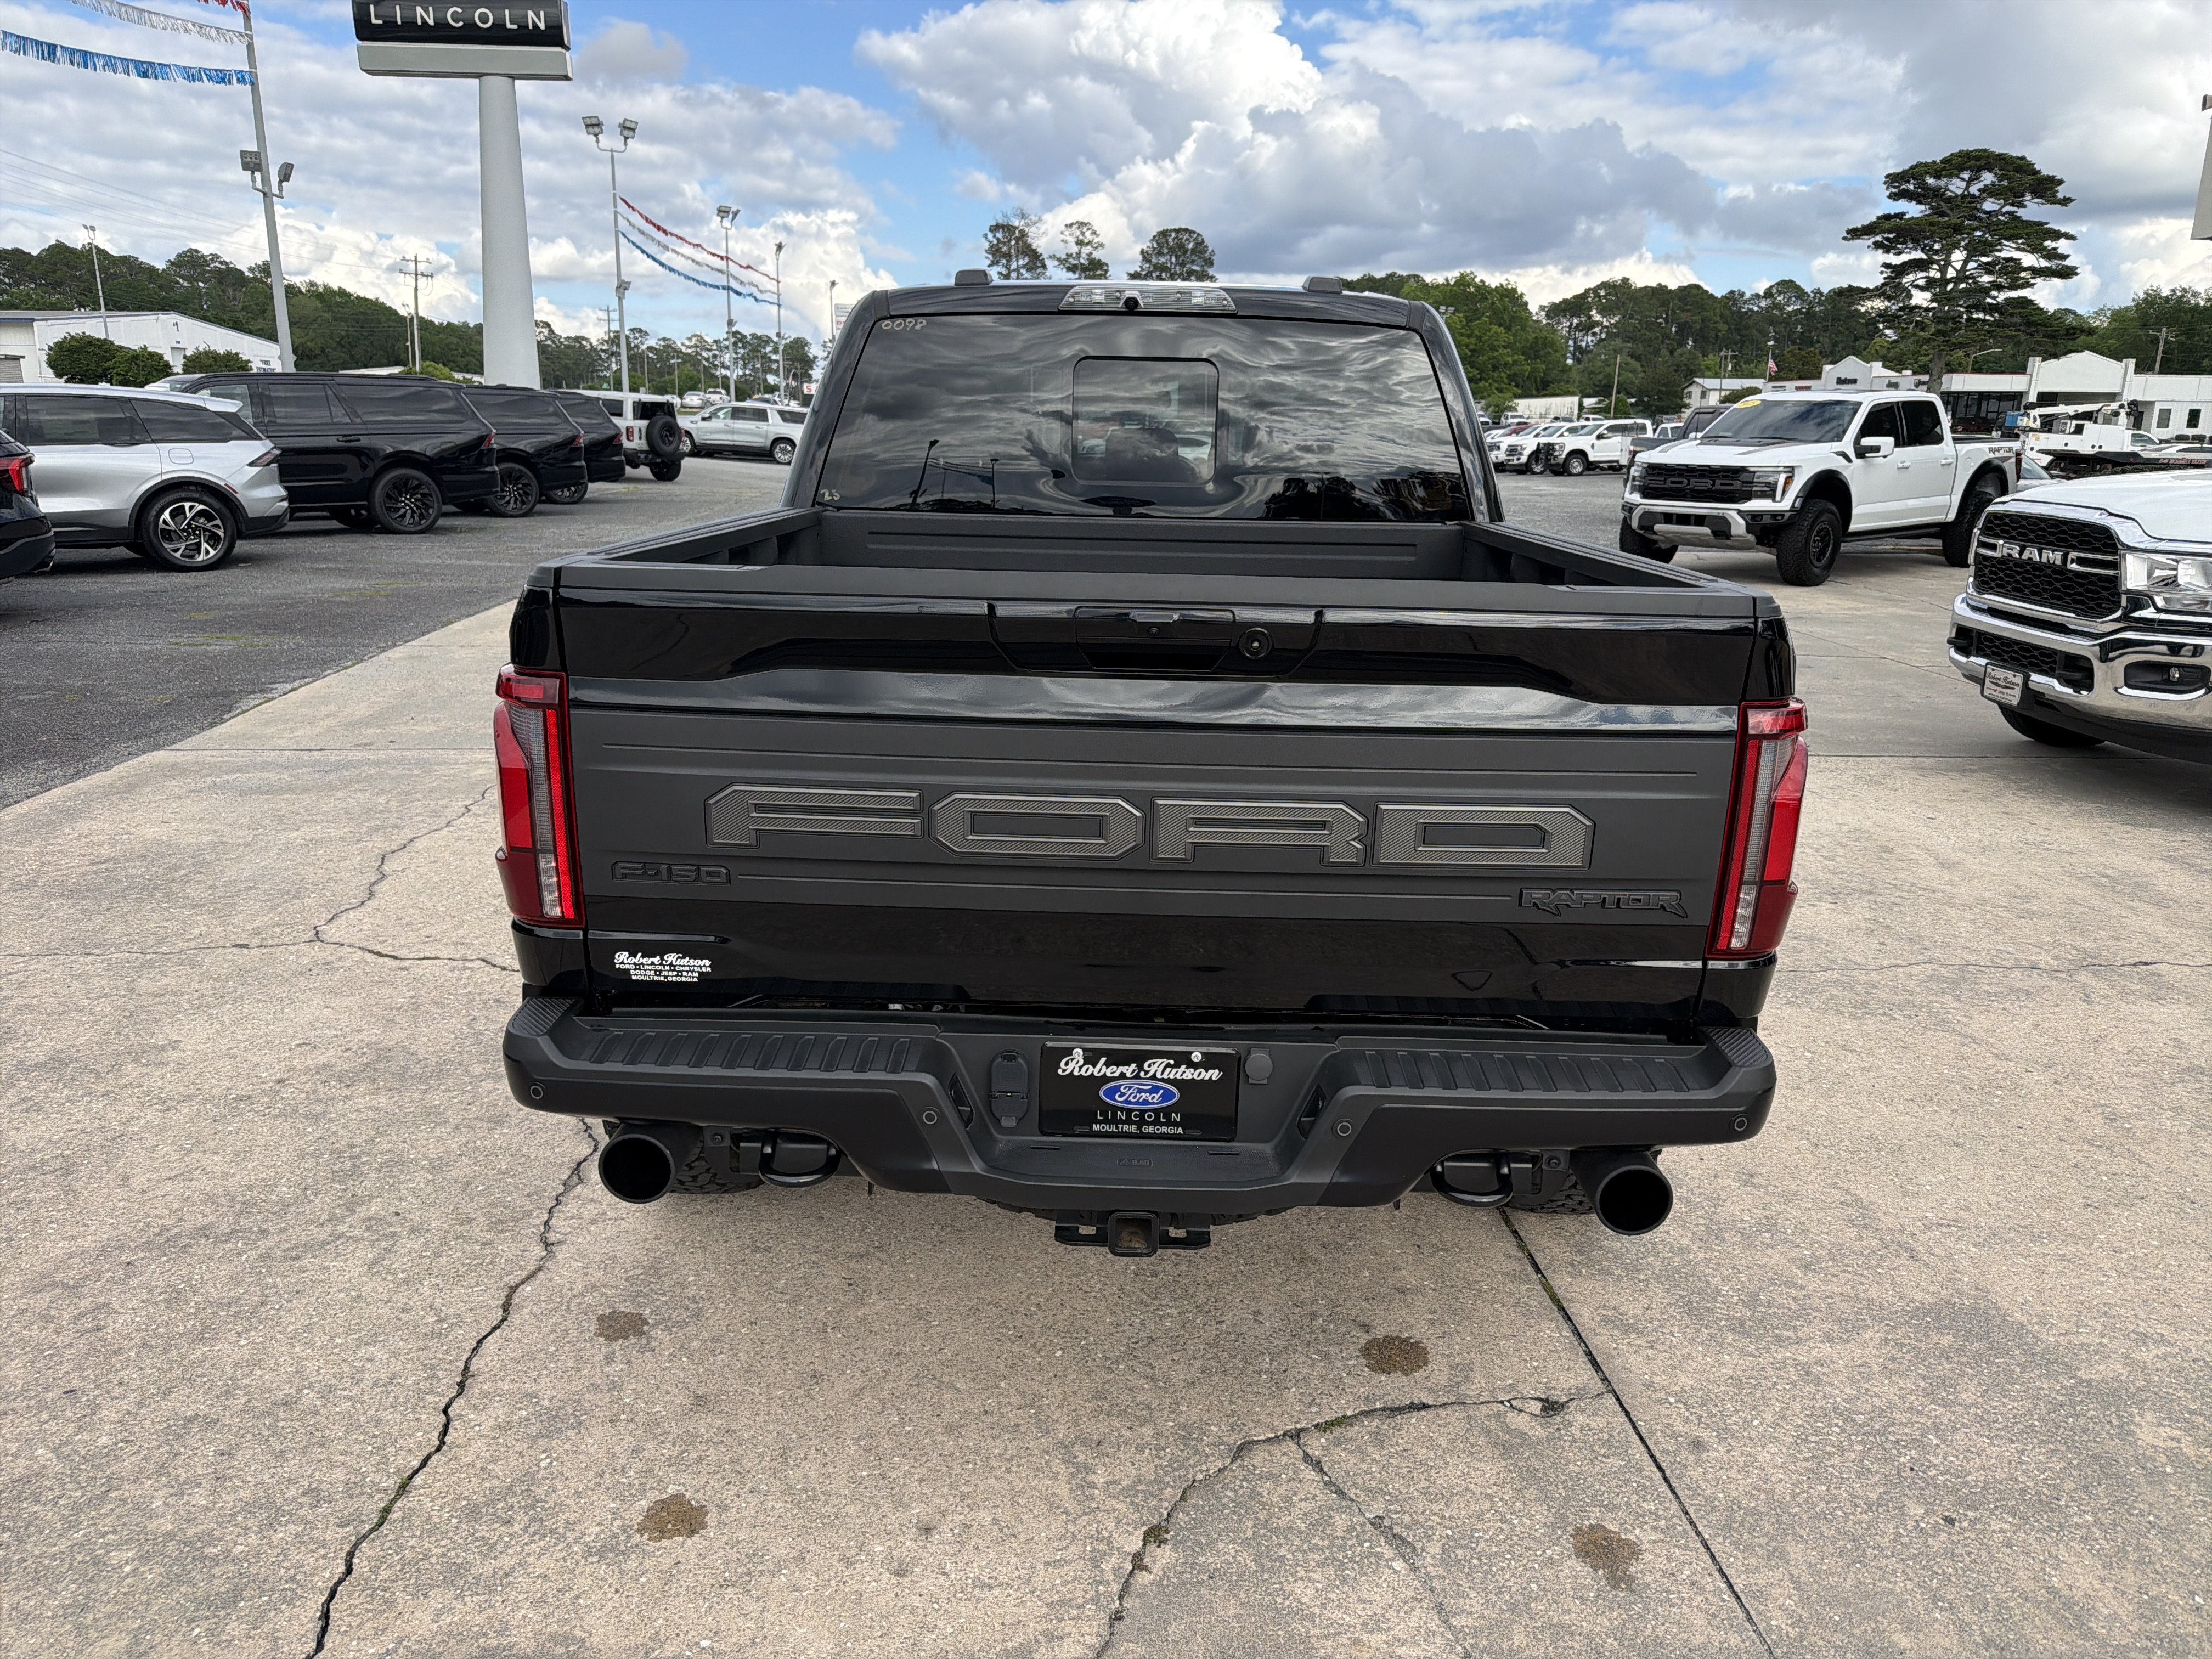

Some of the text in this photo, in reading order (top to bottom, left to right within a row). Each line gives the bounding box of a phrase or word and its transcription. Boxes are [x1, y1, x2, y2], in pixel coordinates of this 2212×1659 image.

[369, 4, 546, 30] LINCOLN
[1988, 447, 2015, 456] RAPTOR
[1644, 477, 1743, 490] FORD
[2002, 544, 2064, 566] RAM
[706, 783, 1594, 870] FORD
[612, 861, 730, 884] F-150
[1519, 888, 1688, 919] RAPTOR
[614, 951, 712, 966] Robert Hutson
[1057, 1056, 1223, 1081] Robert Hutson
[1115, 1084, 1164, 1103] Ford
[1097, 1110, 1181, 1122] LINCOLN
[1092, 1124, 1183, 1135] MOULTRIE, GEORGIA
